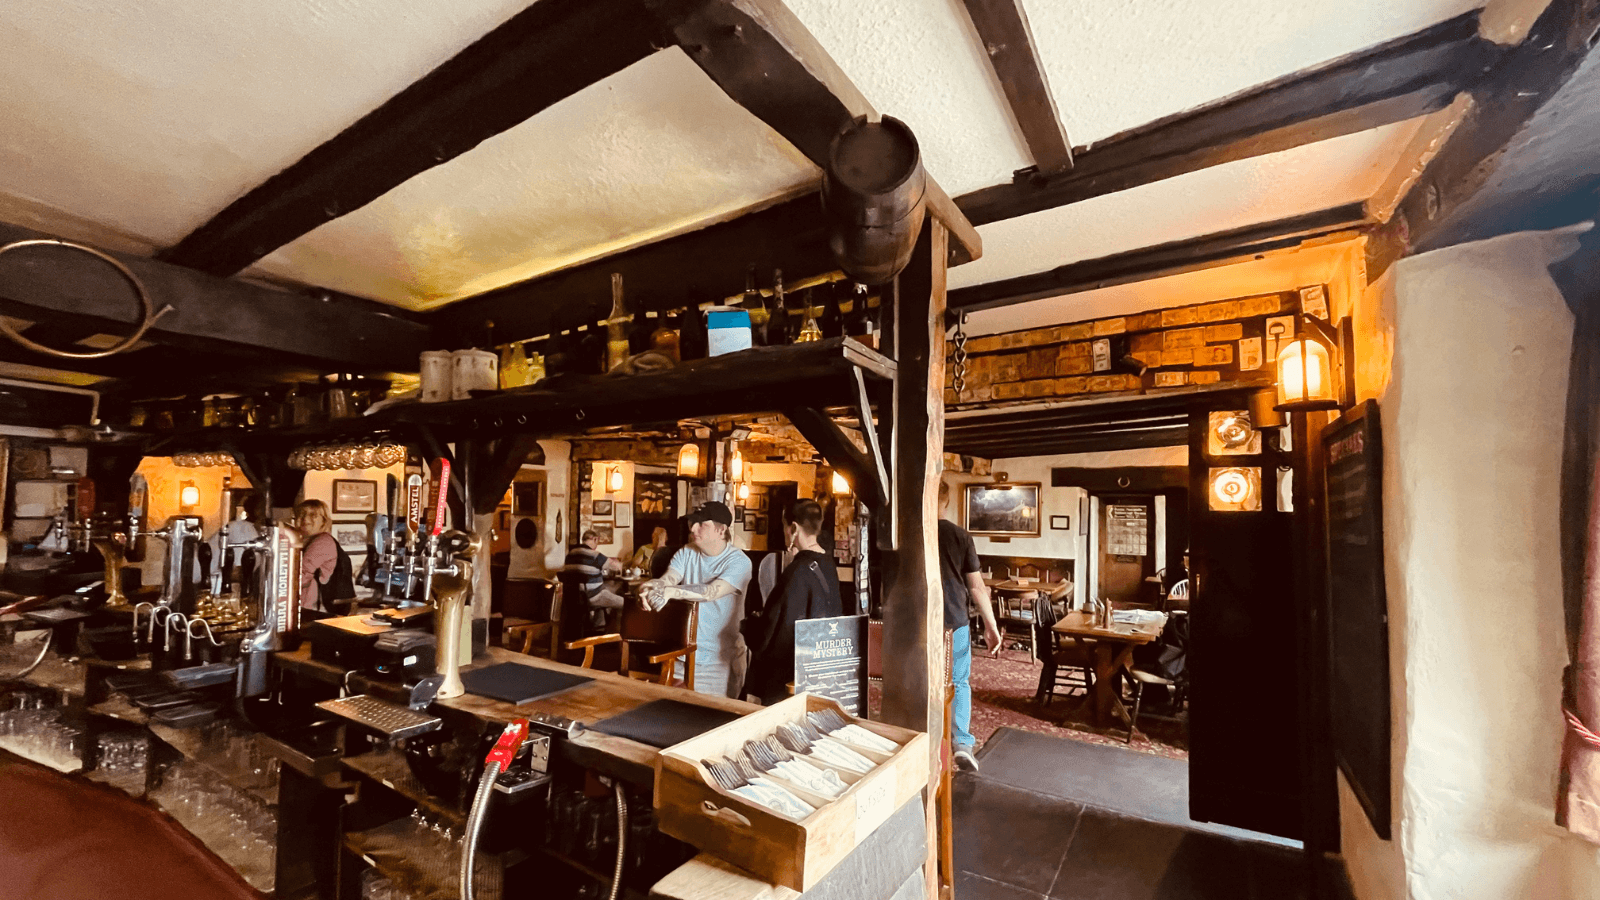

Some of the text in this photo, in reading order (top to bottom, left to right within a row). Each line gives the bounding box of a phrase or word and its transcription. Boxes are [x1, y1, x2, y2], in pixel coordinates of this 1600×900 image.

[411, 487, 419, 523] AMSTEL
[278, 552, 288, 598] MORETTI
[277, 601, 286, 633] BIRRA
[813, 646, 853, 659] MYSTERY
[815, 638, 852, 650] MURDER
